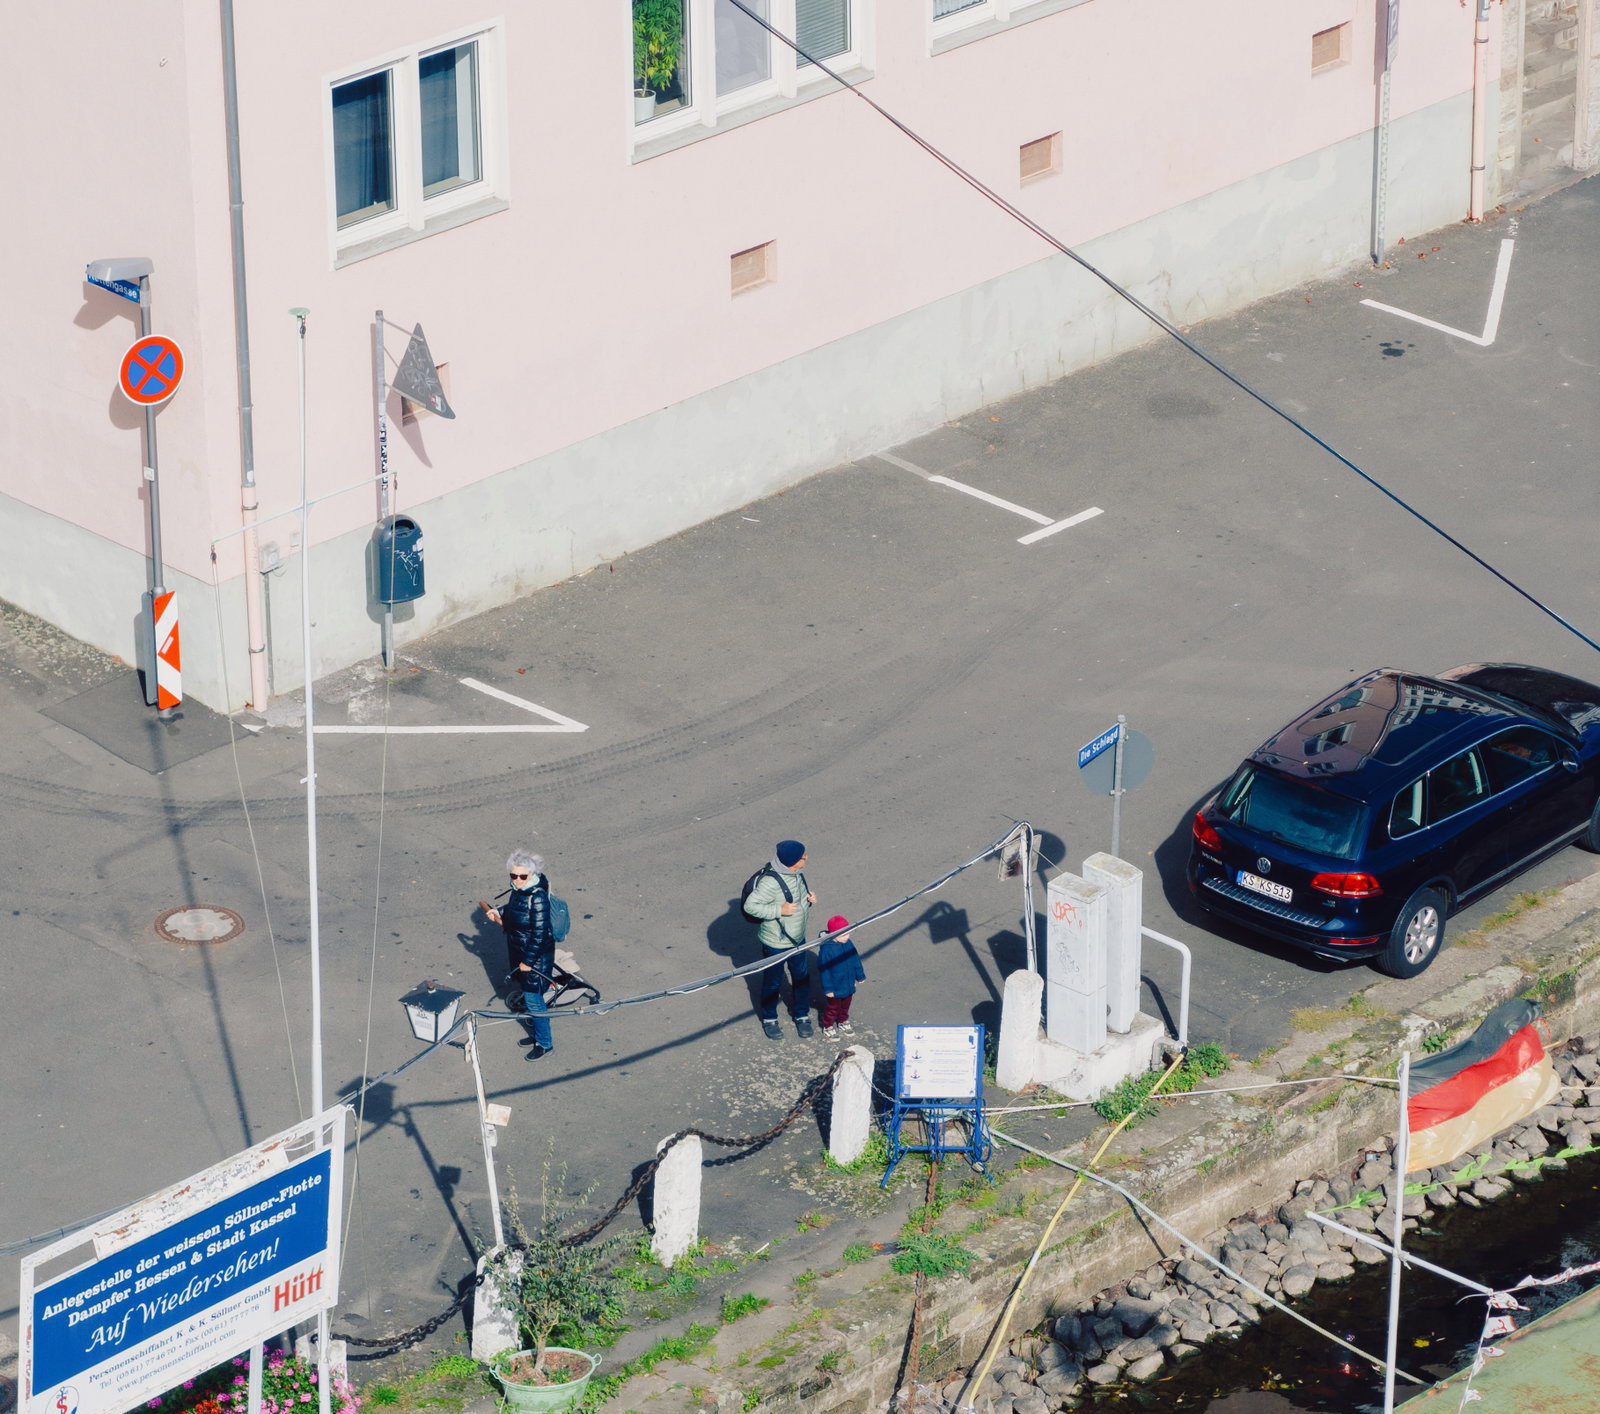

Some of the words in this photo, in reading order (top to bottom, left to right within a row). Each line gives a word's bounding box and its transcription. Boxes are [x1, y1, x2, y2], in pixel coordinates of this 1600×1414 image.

[1080, 749, 1091, 762] Die
[1092, 727, 1119, 754] Schlagd
[1242, 872, 1255, 886] KS
[42, 1268, 133, 1320] Anlegestelle
[135, 1254, 161, 1274] der
[163, 1224, 221, 1259] weissen
[224, 1174, 322, 1230] Söllner-Flotte
[68, 1288, 132, 1327] Dampfer
[134, 1260, 187, 1294] Hessen
[190, 1251, 203, 1265] &
[206, 1228, 246, 1257] Stadt
[249, 1202, 297, 1236] Kassel
[85, 1307, 135, 1352] Auf
[135, 1237, 280, 1324] Wiedersehen!
[274, 1264, 324, 1312] Hütt
[89, 1335, 173, 1383] Personenschiffahrt
[188, 1324, 196, 1333] &
[211, 1300, 242, 1321] Söllner
[244, 1285, 271, 1304] GmbH
[185, 1335, 199, 1346] Fax
